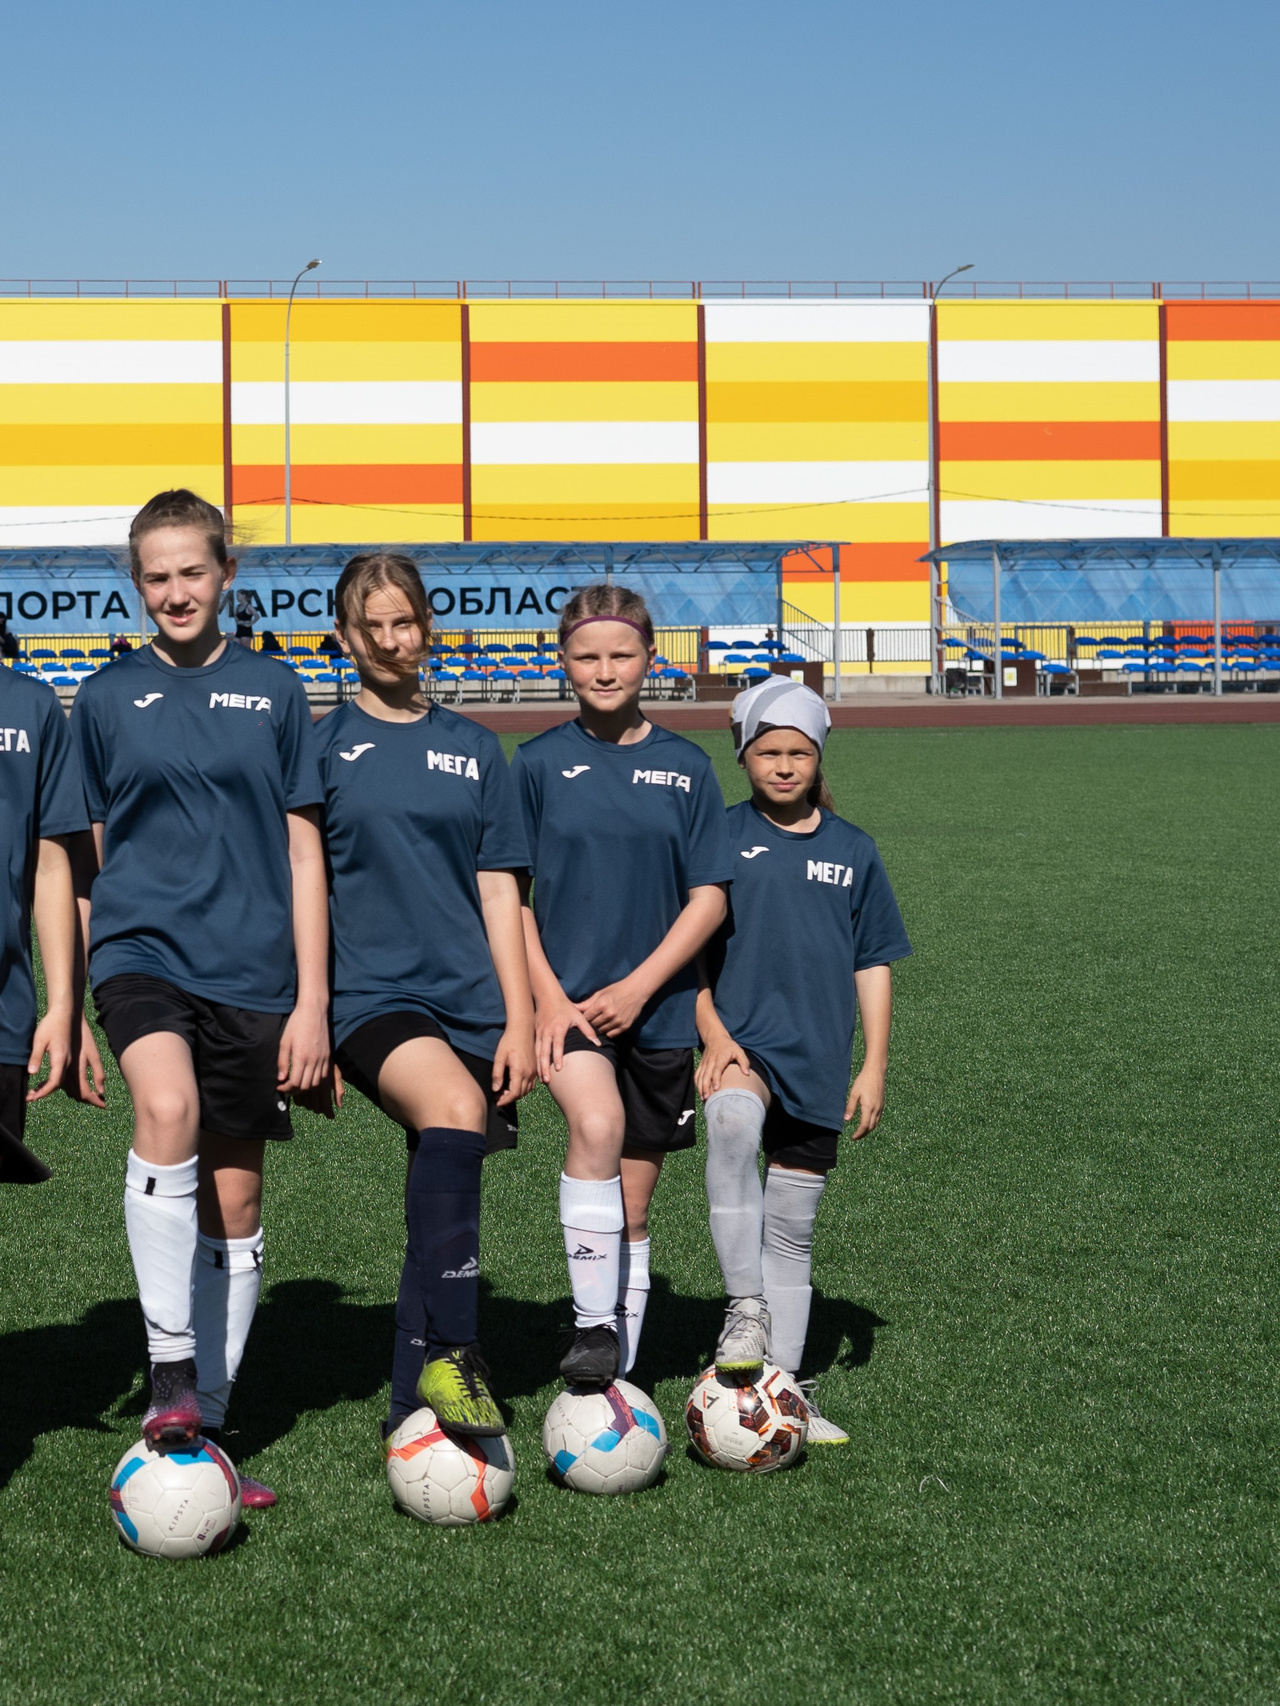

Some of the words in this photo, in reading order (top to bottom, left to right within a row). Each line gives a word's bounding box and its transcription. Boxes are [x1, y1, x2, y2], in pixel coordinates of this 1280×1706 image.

[209, 692, 272, 715] МЕГА
[427, 749, 480, 781] МЕГА
[632, 769, 691, 793] МЕГА
[807, 859, 853, 887] МЕГА
[168, 1499, 189, 1532] KIPSTA
[423, 1484, 433, 1521] KIPSTA
